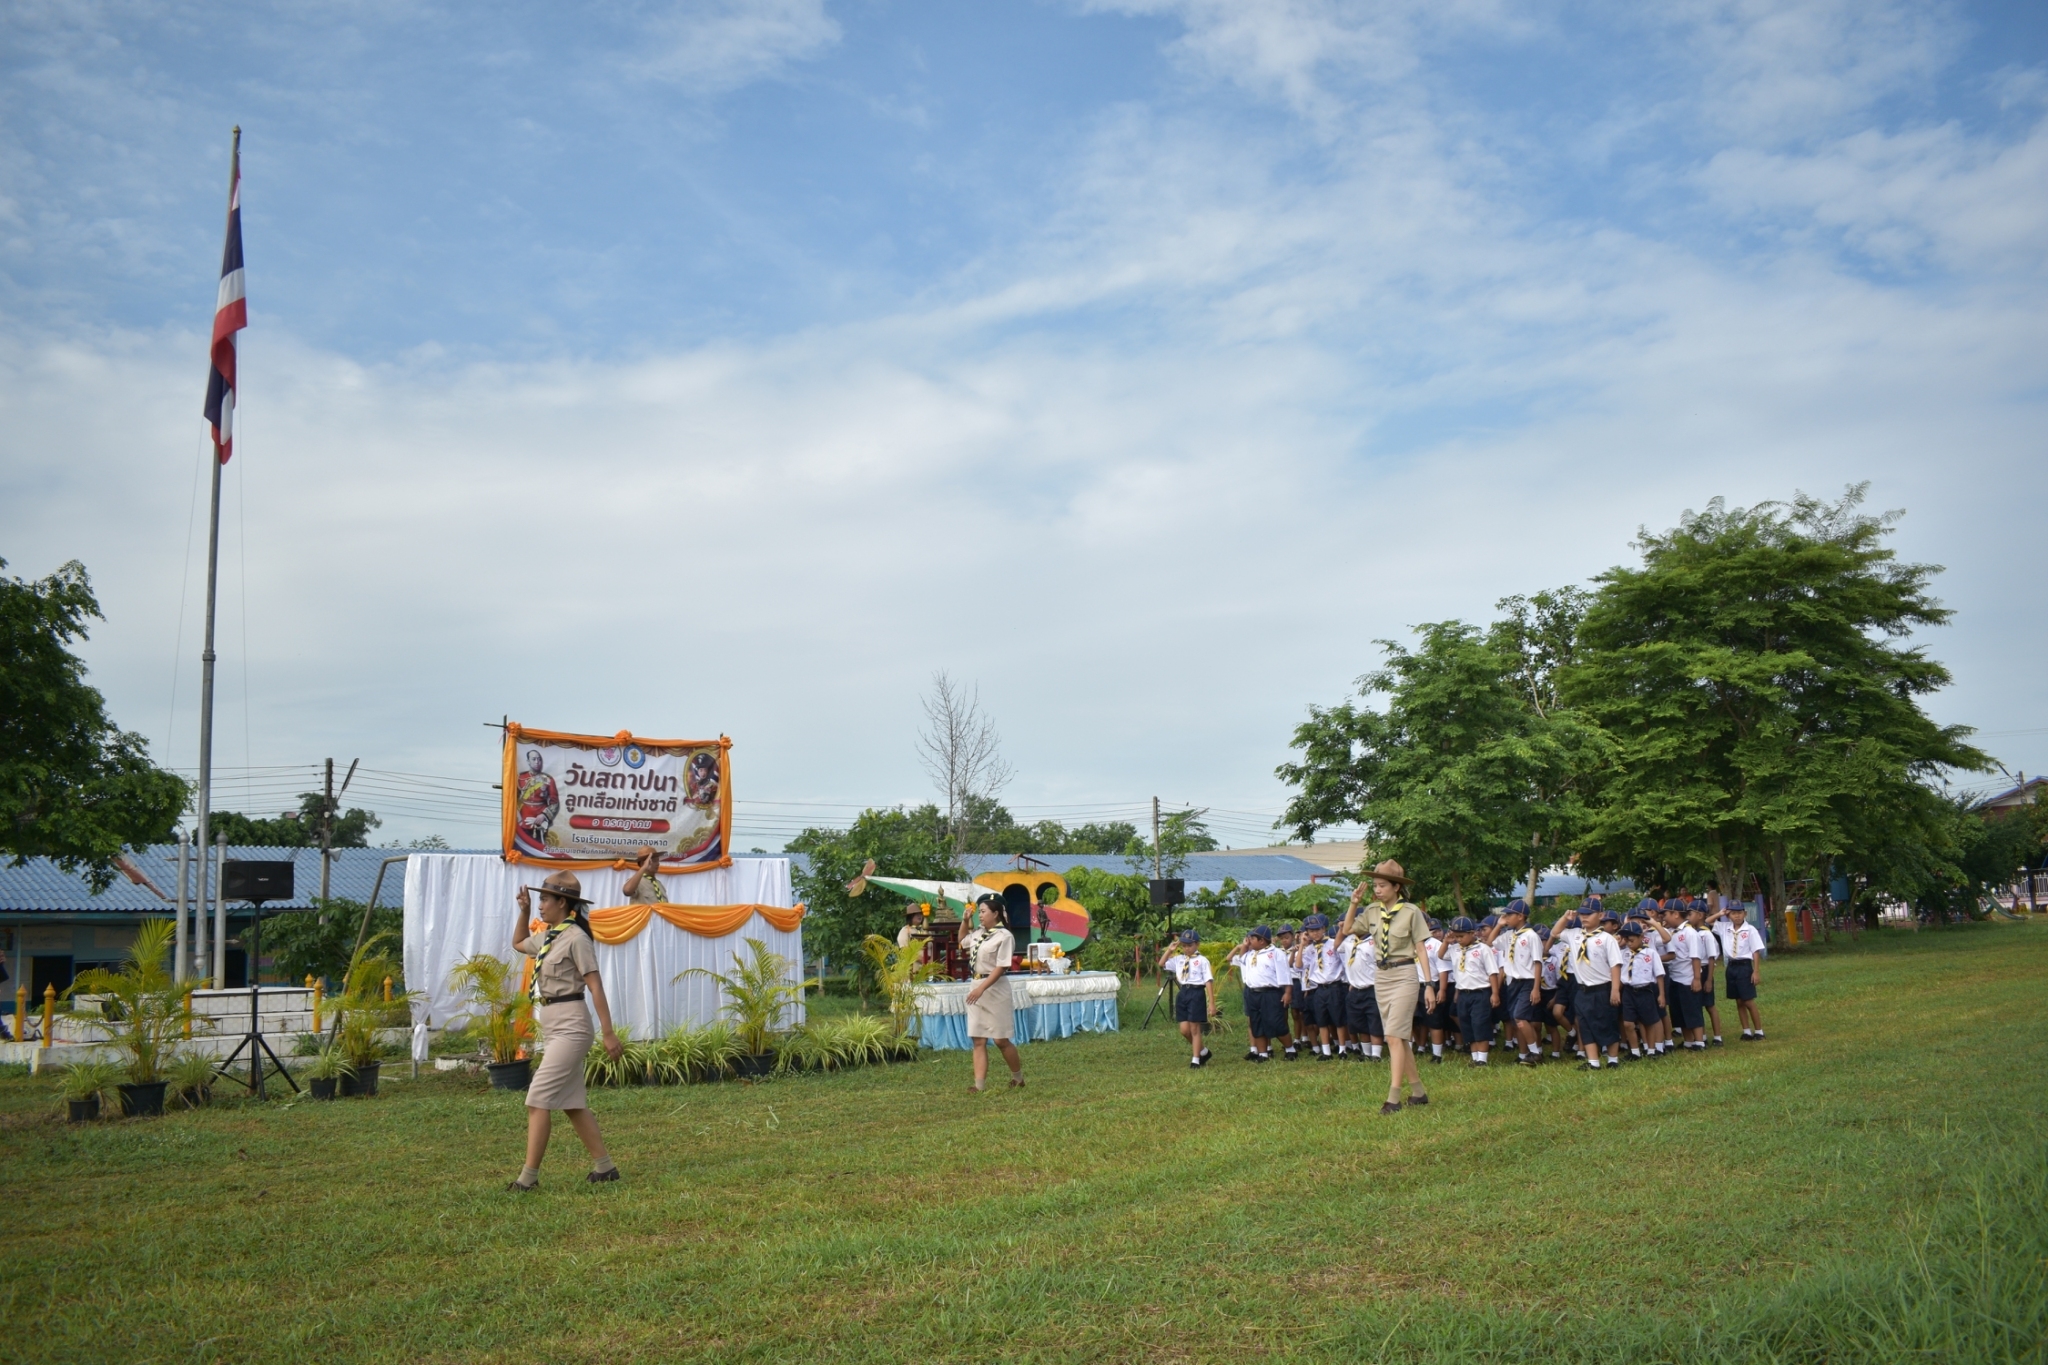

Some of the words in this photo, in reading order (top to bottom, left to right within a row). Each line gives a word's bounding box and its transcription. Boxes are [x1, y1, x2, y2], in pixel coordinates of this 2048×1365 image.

[564, 762, 678, 793] วันสถาปนา
[565, 791, 678, 813] ลูกเสือแห่งชาติ
[602, 817, 652, 831] กรกฎาคม
